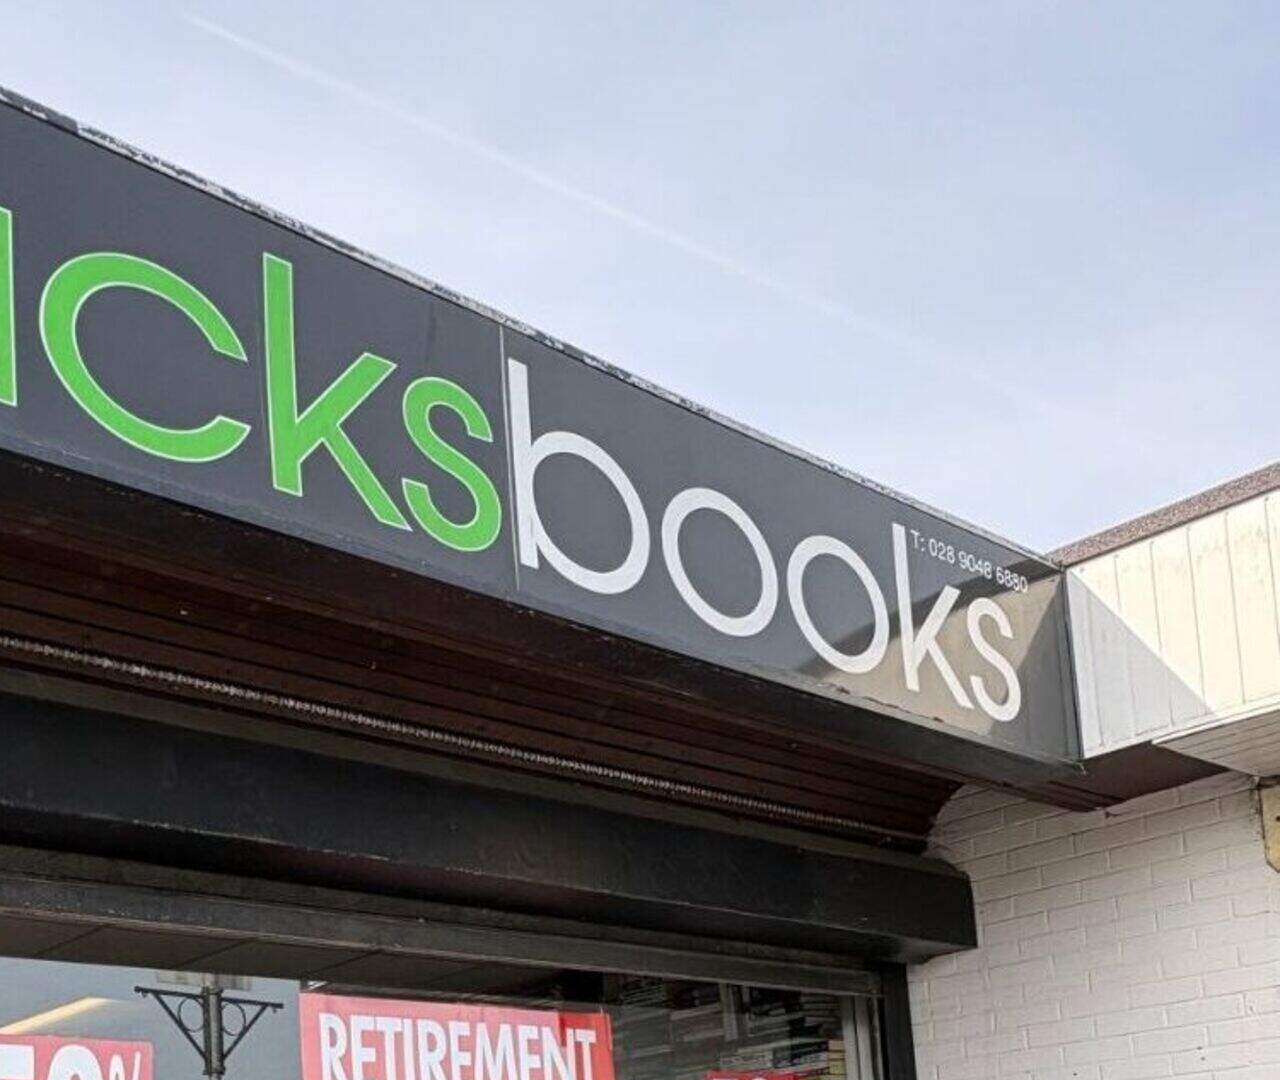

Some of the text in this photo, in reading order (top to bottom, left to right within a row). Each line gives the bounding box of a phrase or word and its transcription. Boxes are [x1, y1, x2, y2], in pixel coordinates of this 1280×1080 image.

[910, 530, 1029, 593] T: 028 9048 6880
